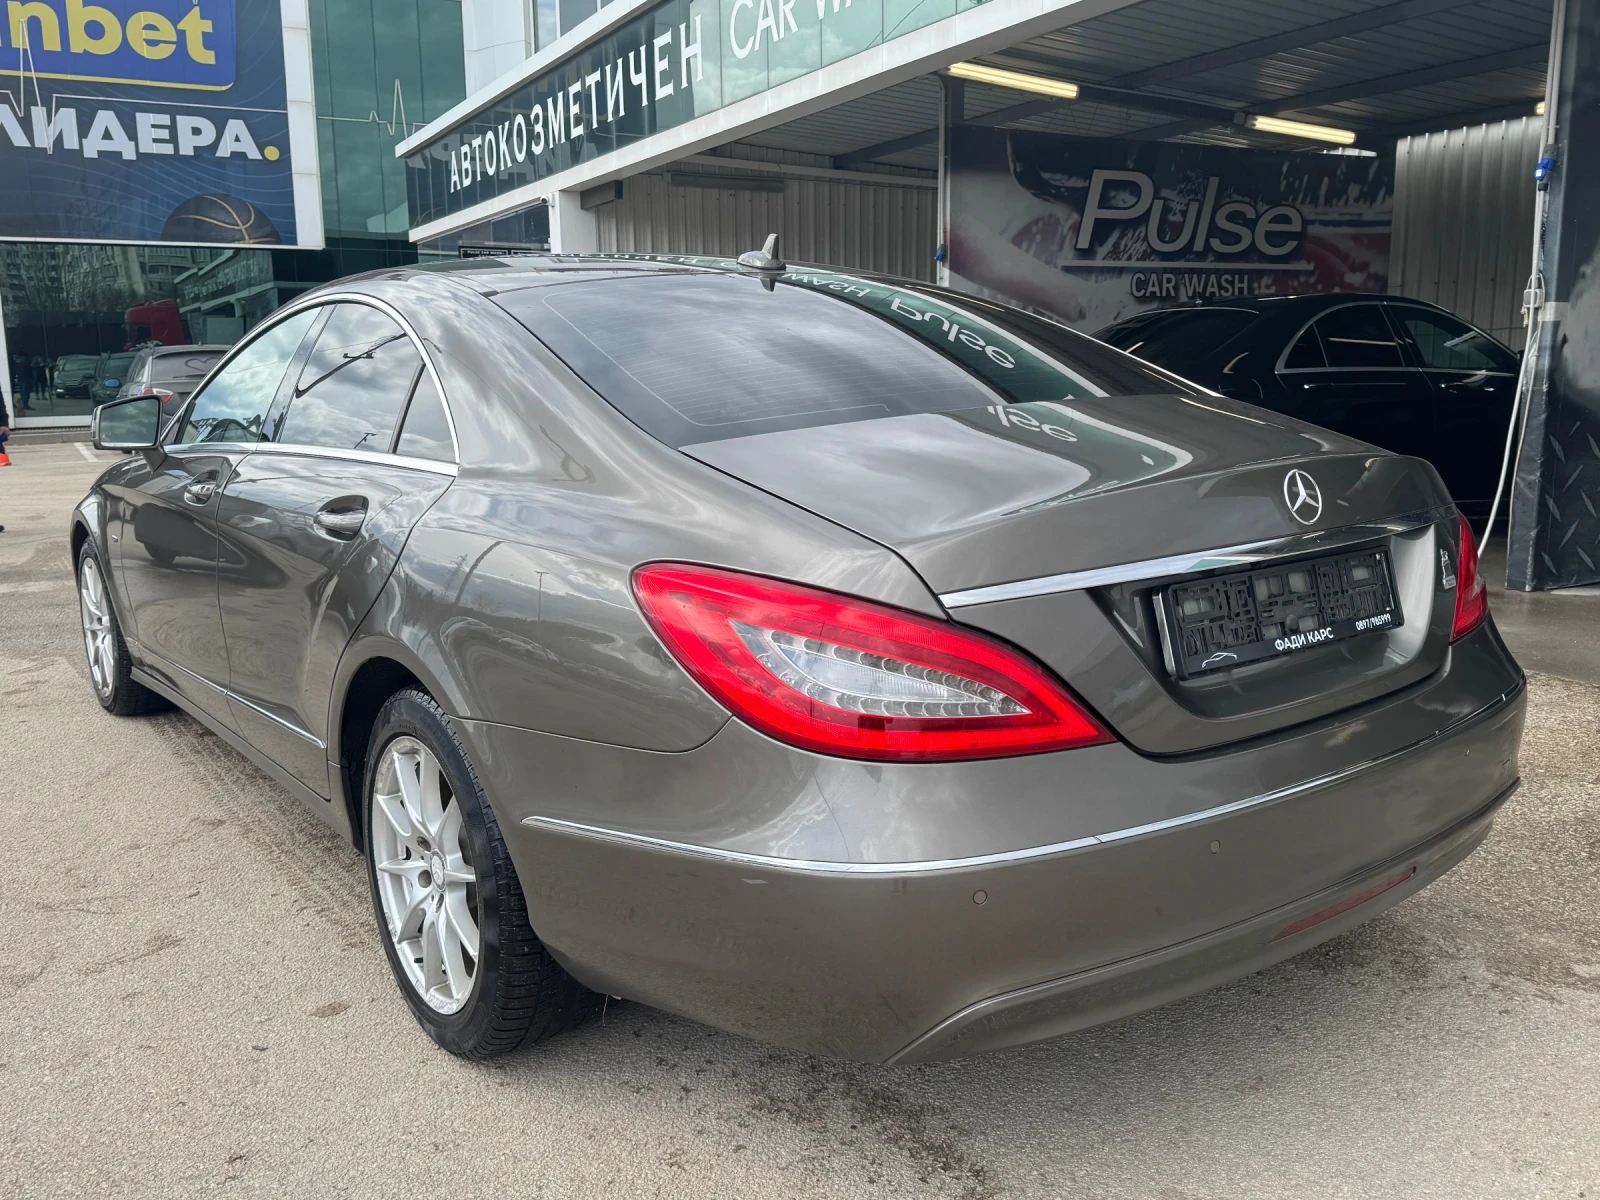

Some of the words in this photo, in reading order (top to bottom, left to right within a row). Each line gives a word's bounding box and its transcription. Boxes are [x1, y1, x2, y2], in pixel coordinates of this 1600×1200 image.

[0, 0, 216, 64] nbet
[729, 0, 799, 59] CAR
[450, 14, 704, 194] АВТОКОЗМЕТИЧЕН
[1075, 169, 1303, 256] Pulse
[1131, 272, 1176, 297] CAR
[1185, 273, 1249, 298] WASH
[1274, 634, 1306, 651] ФАДИ
[1307, 627, 1334, 643] КАРС
